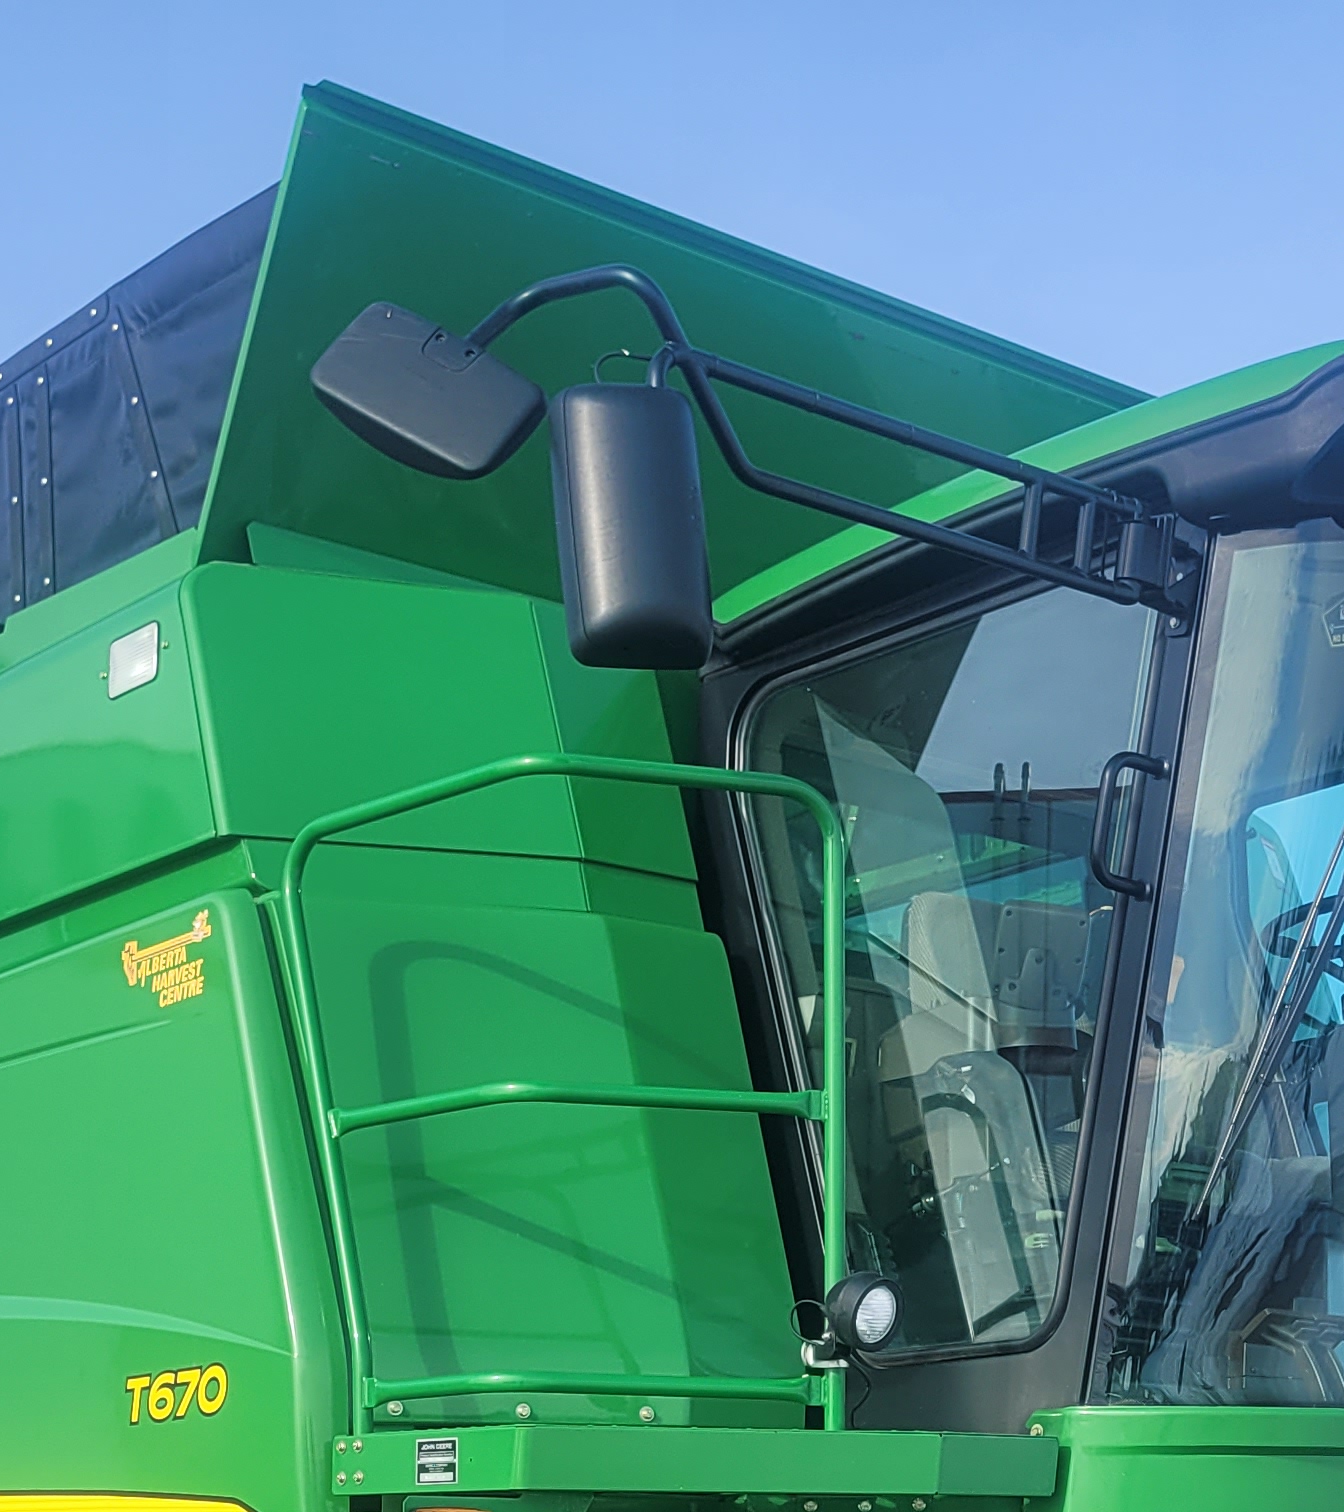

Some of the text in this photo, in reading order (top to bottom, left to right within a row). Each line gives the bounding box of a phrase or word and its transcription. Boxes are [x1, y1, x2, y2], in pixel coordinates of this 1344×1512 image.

[152, 958, 204, 993] HARVEST
[159, 976, 205, 1008] CENTRE
[125, 1363, 228, 1425] T670
